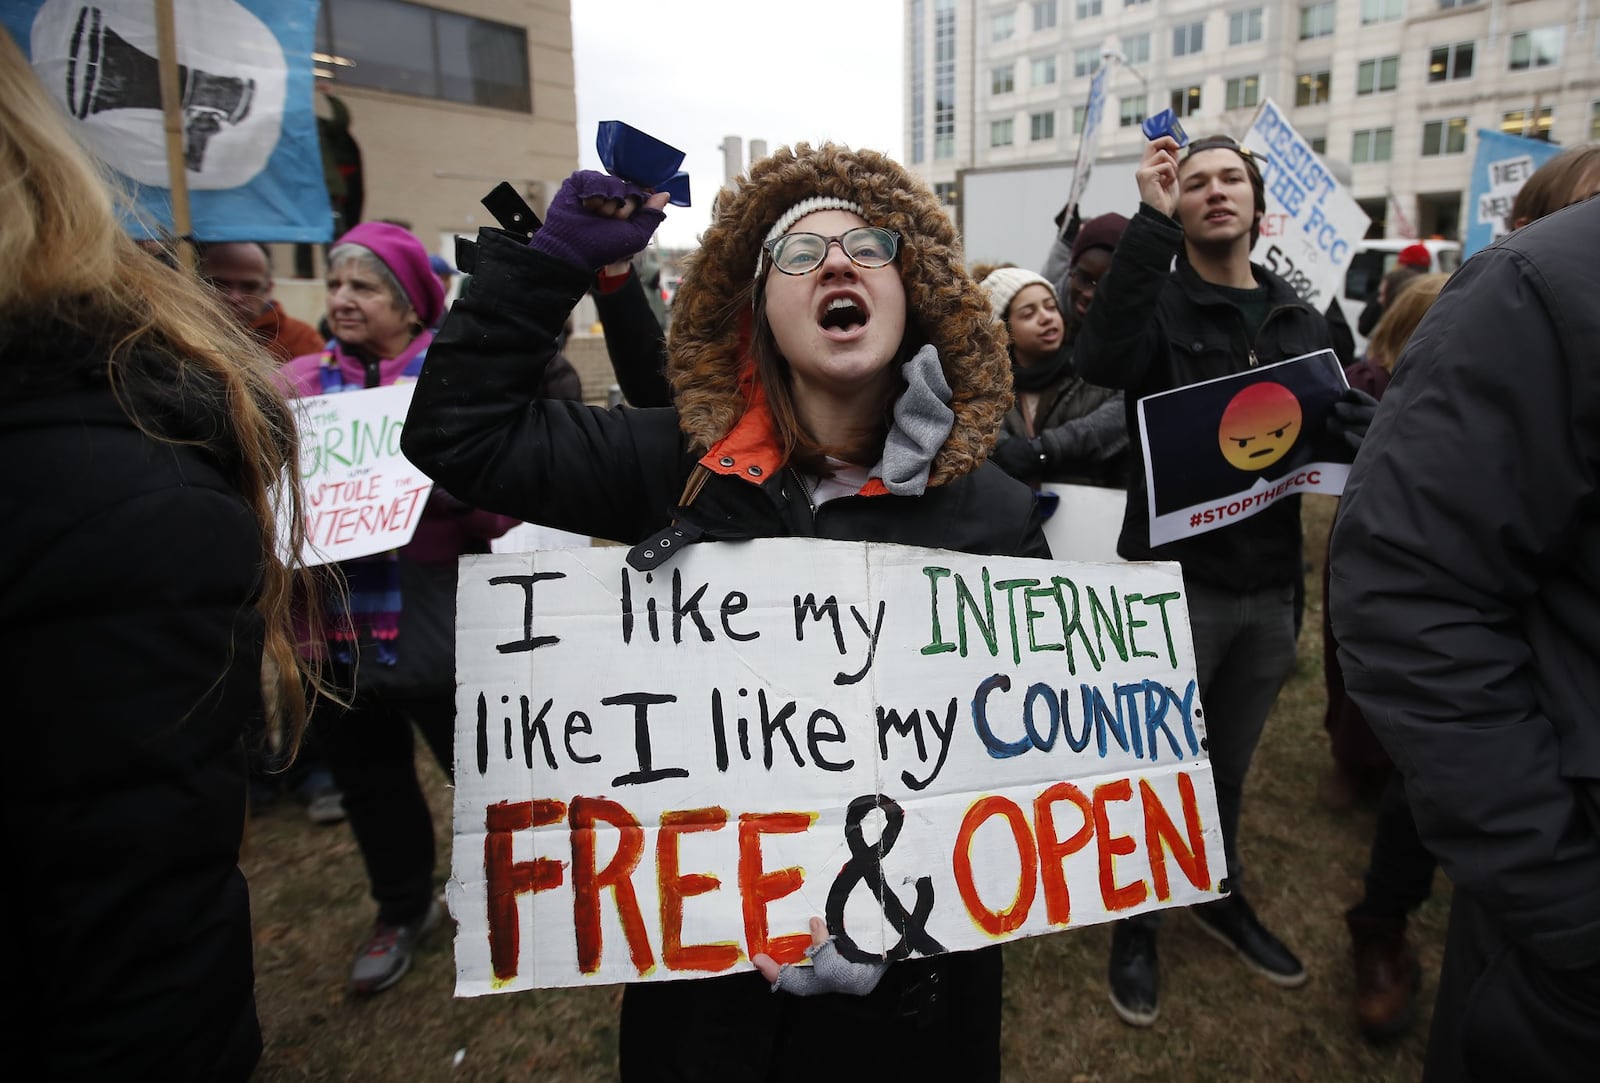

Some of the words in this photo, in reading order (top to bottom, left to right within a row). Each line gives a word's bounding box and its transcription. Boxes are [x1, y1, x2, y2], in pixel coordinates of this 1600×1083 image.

[1254, 104, 1336, 206] RESIST
[1492, 161, 1529, 187] NET
[1261, 153, 1307, 218] THE
[1303, 206, 1350, 265] FCC
[300, 415, 404, 478] GRINC
[304, 484, 432, 546] NTERNET
[309, 474, 382, 507] STOLE
[1189, 470, 1322, 528] #STOPTHEFCC
[488, 571, 566, 654] I
[620, 567, 760, 644] like
[794, 592, 886, 685] my
[920, 566, 1181, 675] INTERNET
[476, 690, 602, 776] like
[600, 692, 690, 788] I
[711, 687, 855, 773] like
[876, 697, 958, 790] my
[484, 794, 821, 990] FREE
[825, 793, 950, 965] &
